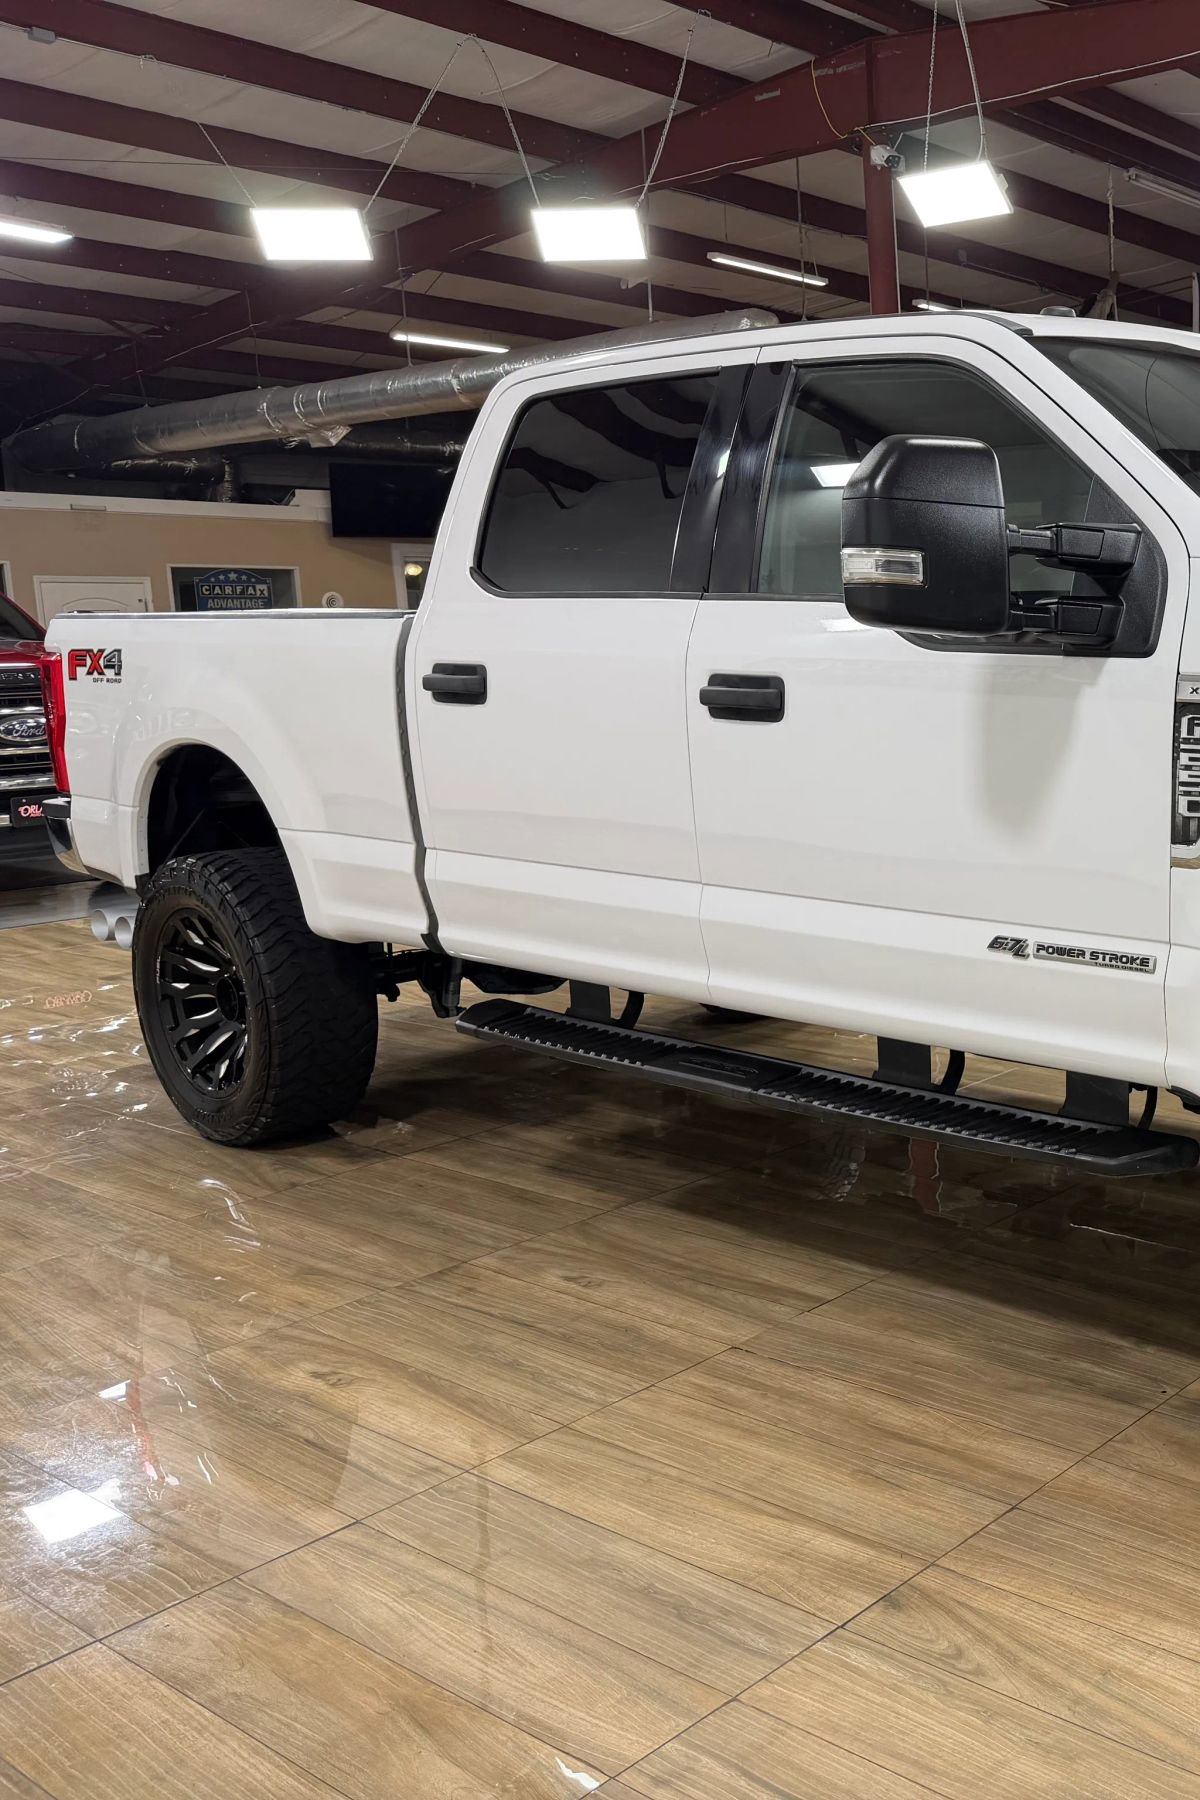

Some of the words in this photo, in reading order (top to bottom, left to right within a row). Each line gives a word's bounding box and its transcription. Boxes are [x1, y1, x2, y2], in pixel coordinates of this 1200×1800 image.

[201, 585, 267, 597] CARFAX
[207, 599, 265, 609] ADVANTAGE
[67, 648, 122, 681] FX4
[12, 722, 45, 739] Ford
[1035, 943, 1086, 960] POWER
[1089, 950, 1150, 968] STROKE
